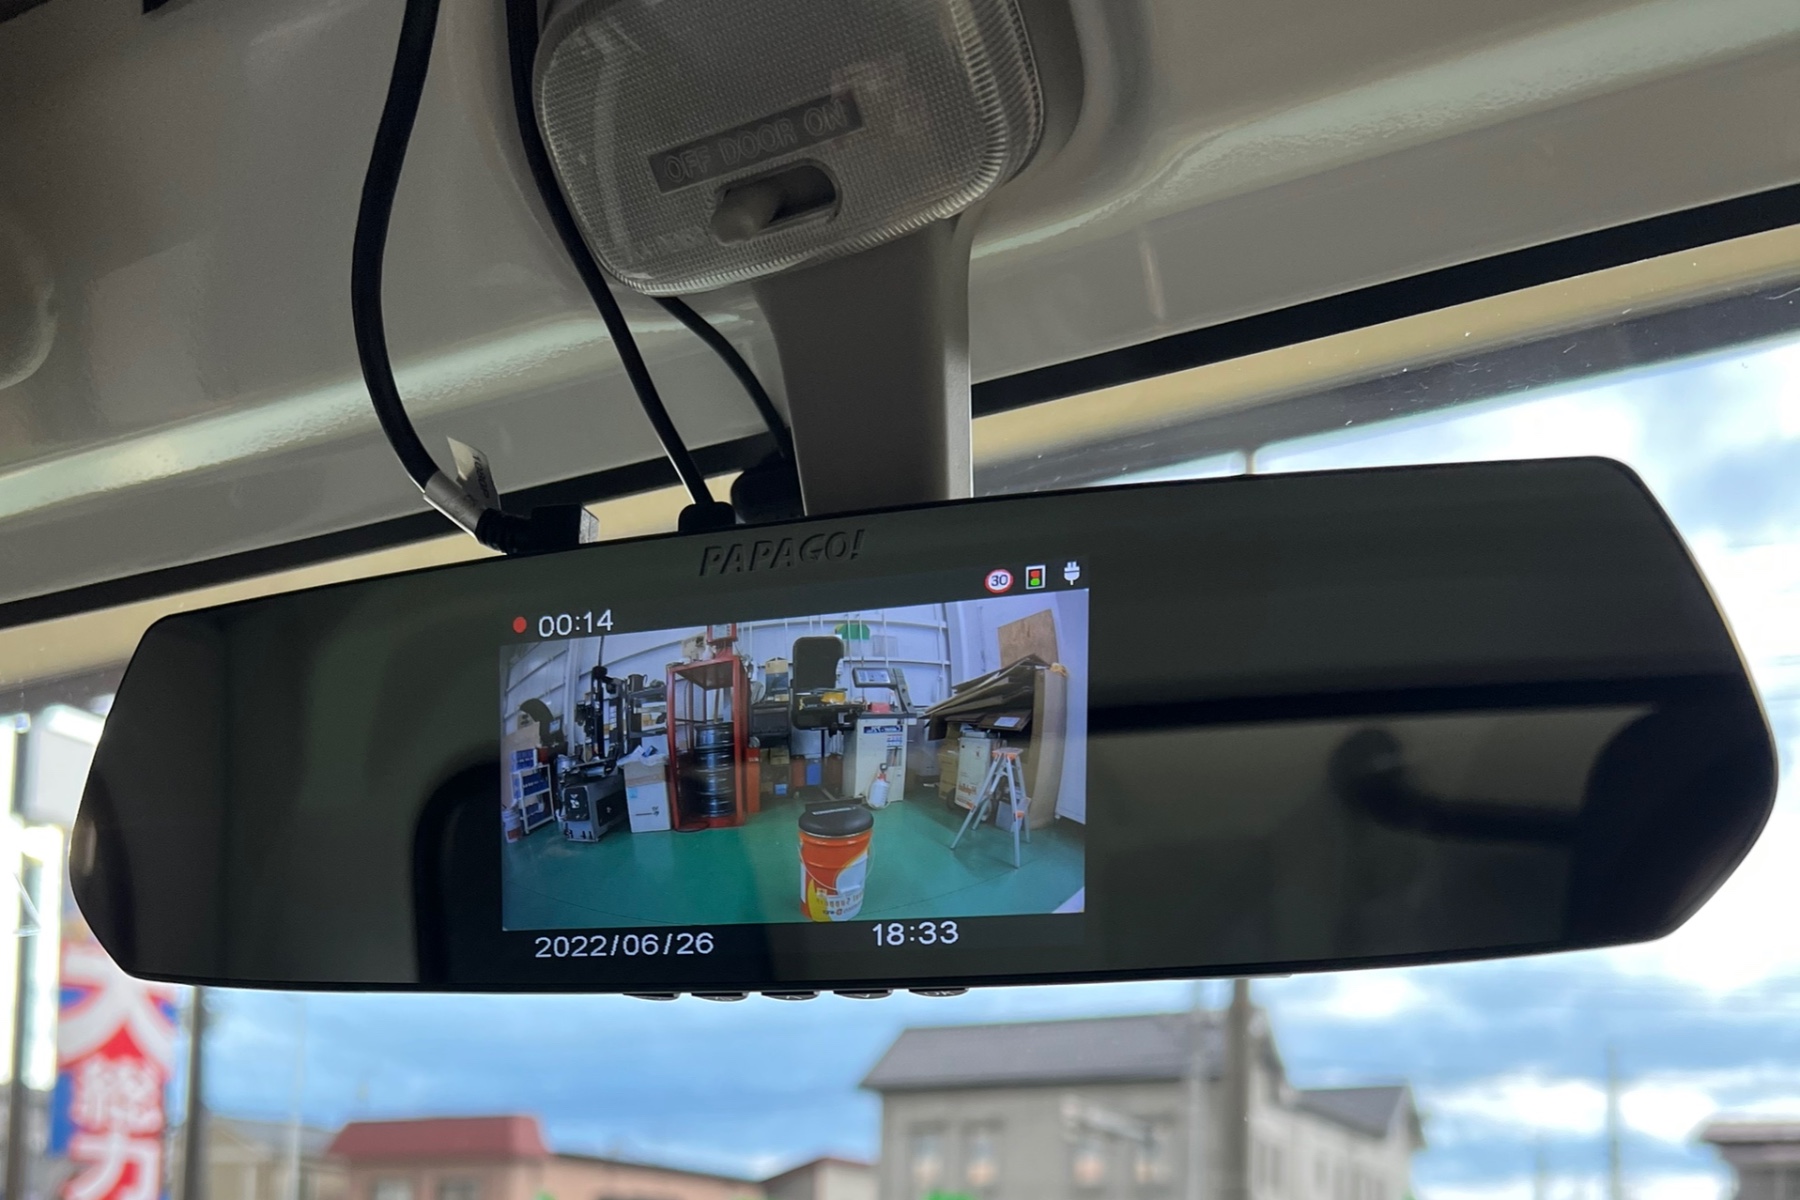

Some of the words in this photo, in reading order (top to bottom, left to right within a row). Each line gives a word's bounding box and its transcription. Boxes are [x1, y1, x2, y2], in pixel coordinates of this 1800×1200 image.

[664, 146, 711, 183] OFF
[718, 118, 798, 166] DOOR
[803, 99, 848, 137] ON
[699, 529, 866, 577] PAPAGO!
[991, 574, 1009, 587] 30
[538, 609, 614, 637] 00:14
[534, 931, 714, 959] 2022/06/26
[872, 921, 959, 947] 18:33
